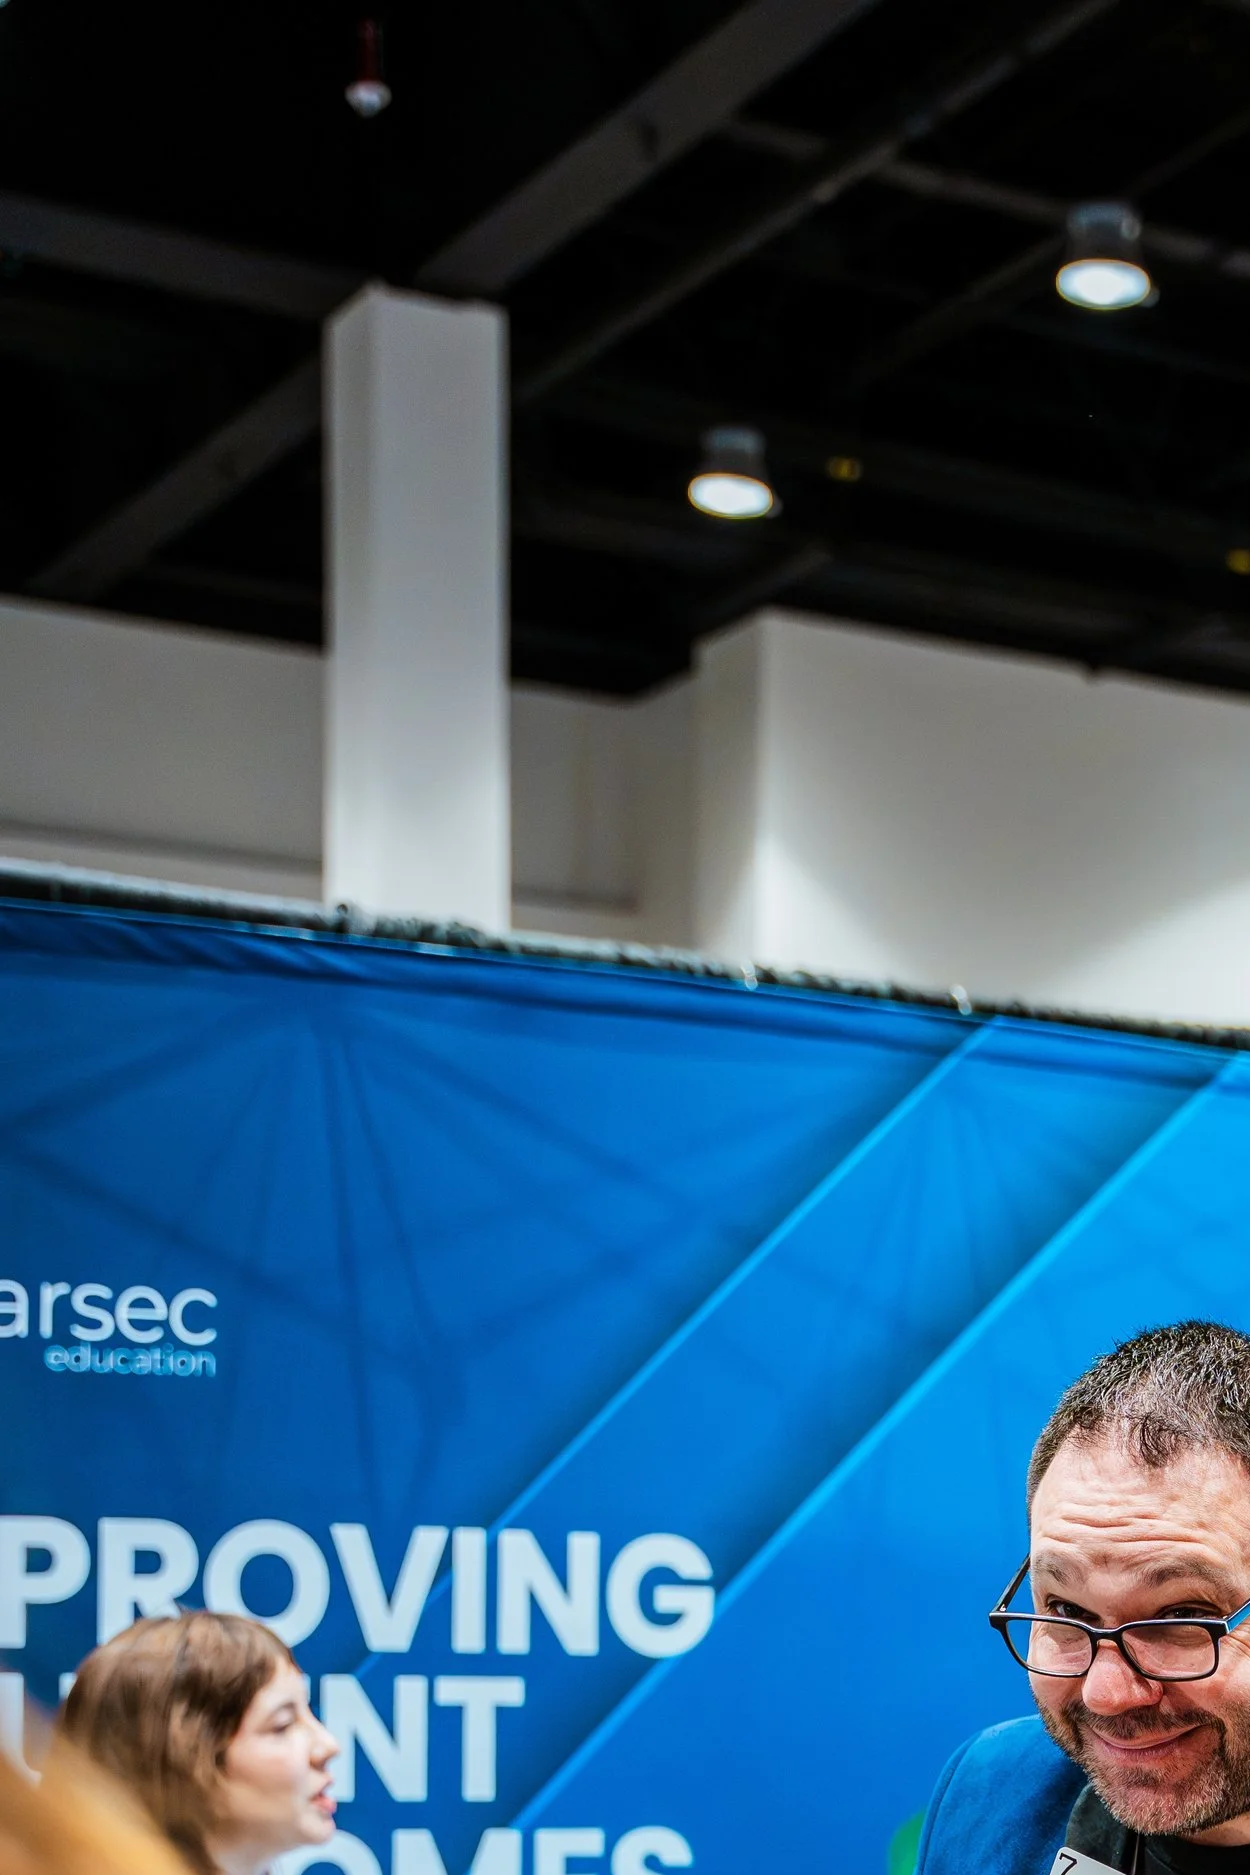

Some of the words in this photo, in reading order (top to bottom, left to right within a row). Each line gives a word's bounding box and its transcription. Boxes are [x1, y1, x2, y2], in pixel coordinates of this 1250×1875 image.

[0, 1279, 218, 1346] arsec
[44, 1342, 216, 1378] education
[0, 1516, 715, 1658] PROVING
